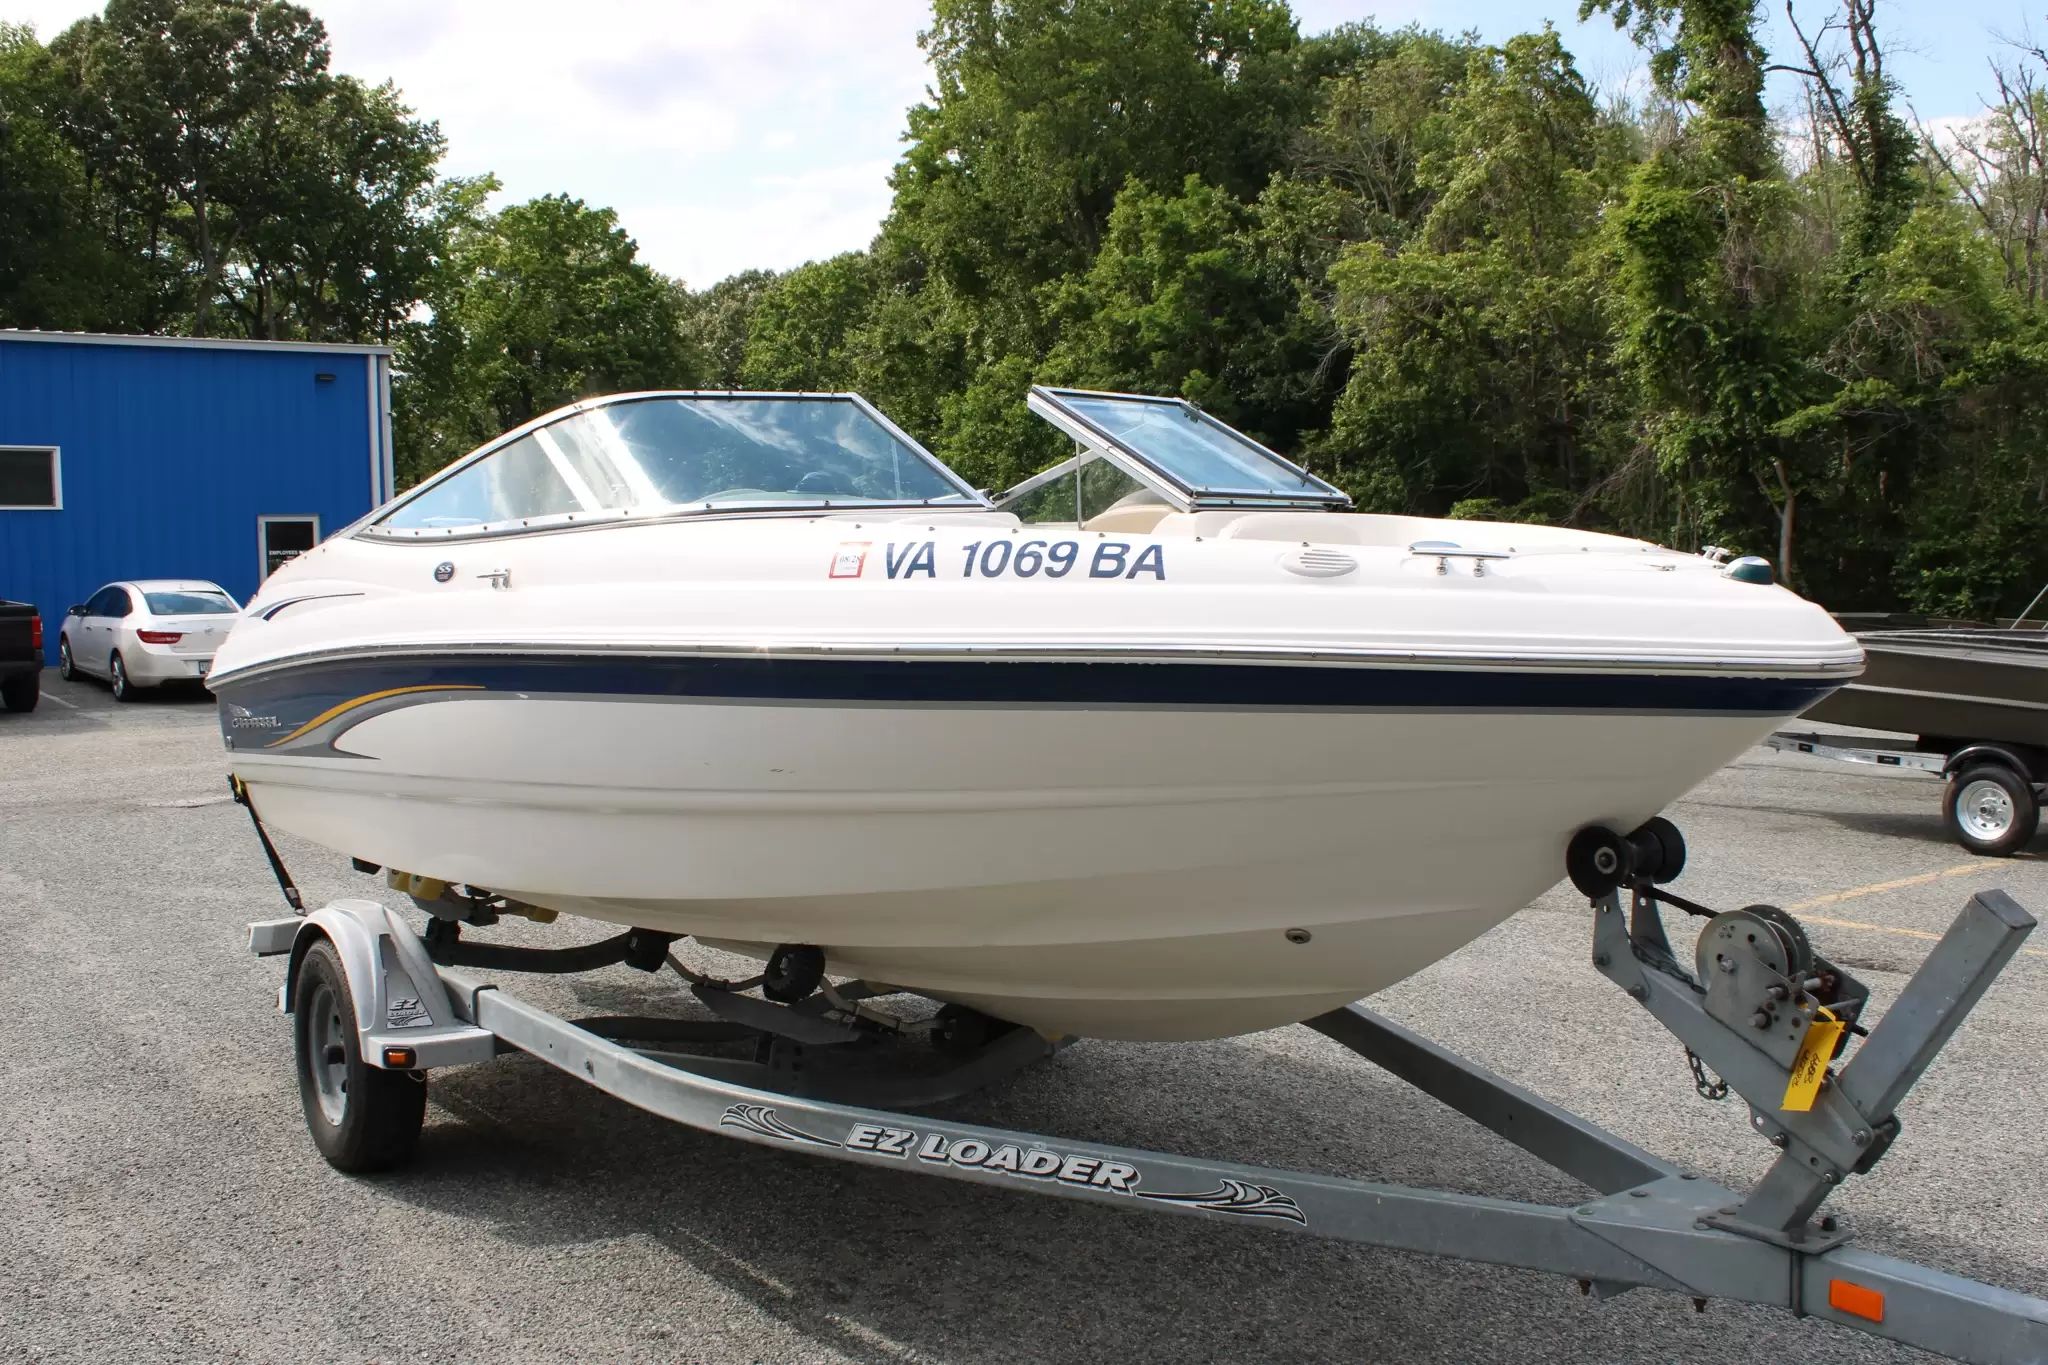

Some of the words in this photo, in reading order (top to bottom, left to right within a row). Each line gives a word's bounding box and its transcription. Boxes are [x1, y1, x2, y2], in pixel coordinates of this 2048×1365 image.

[886, 541, 937, 579] VA
[962, 540, 1079, 578] 1069
[1089, 542, 1166, 580] BA
[389, 998, 419, 1011] EZ
[845, 1122, 917, 1158] EZ
[918, 1133, 1141, 1196] LOADER
